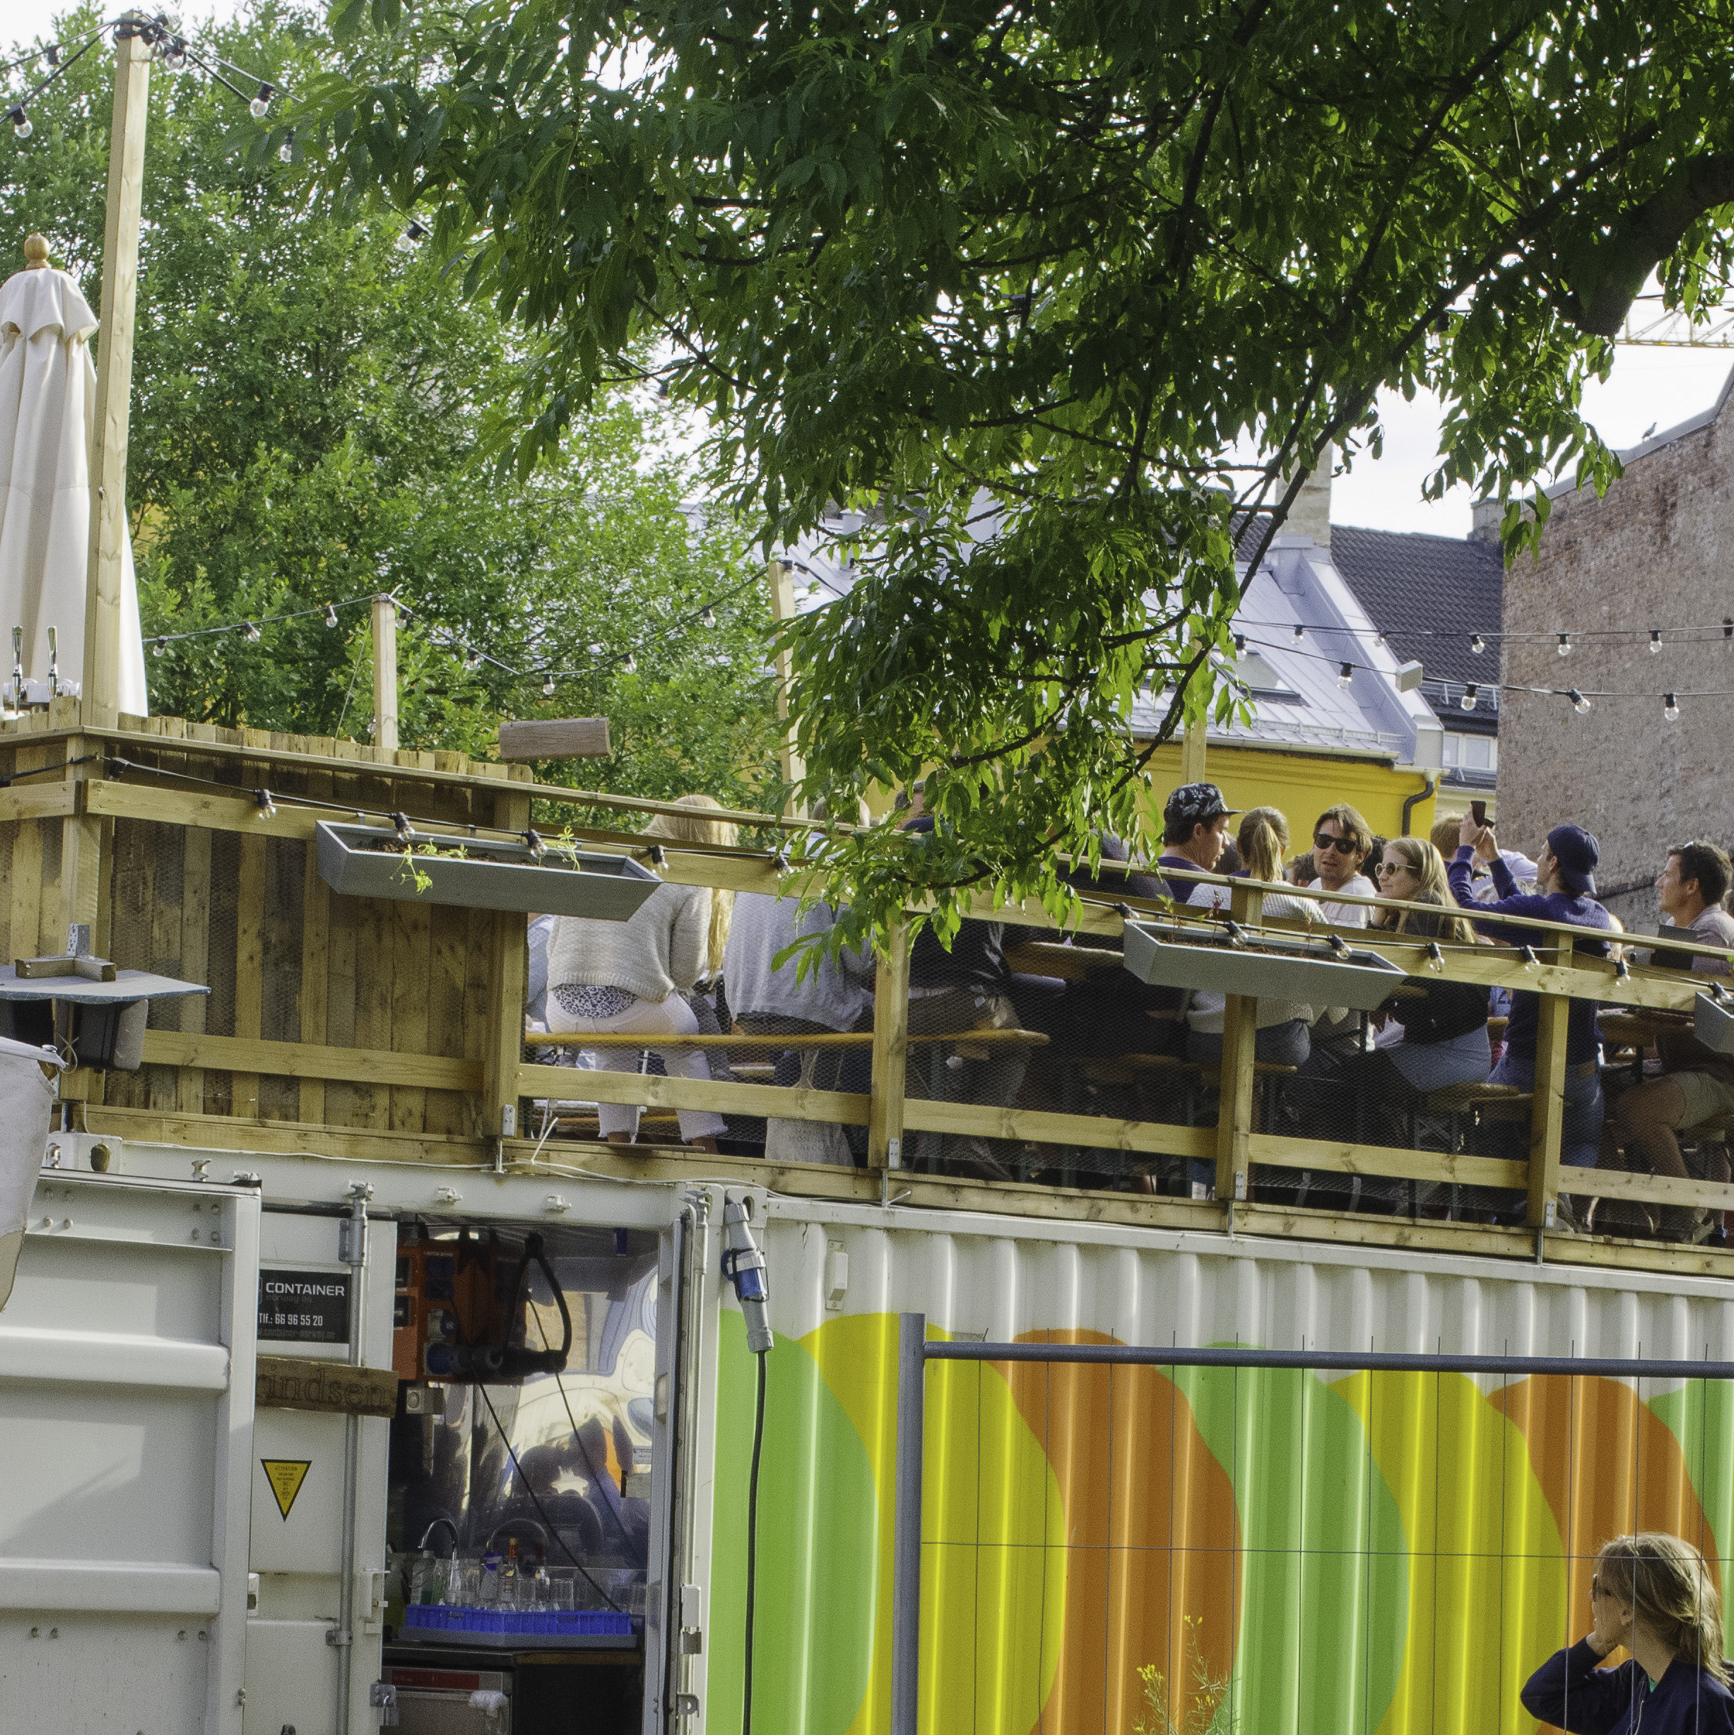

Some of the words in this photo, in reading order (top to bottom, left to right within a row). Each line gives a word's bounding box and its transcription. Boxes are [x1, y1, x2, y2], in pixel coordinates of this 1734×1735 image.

[266, 1282, 345, 1296] CONTAINER
[275, 1313, 286, 1325] 66
[287, 1314, 298, 1325] 96
[300, 1315, 311, 1326] 55
[313, 1315, 323, 1326] 20
